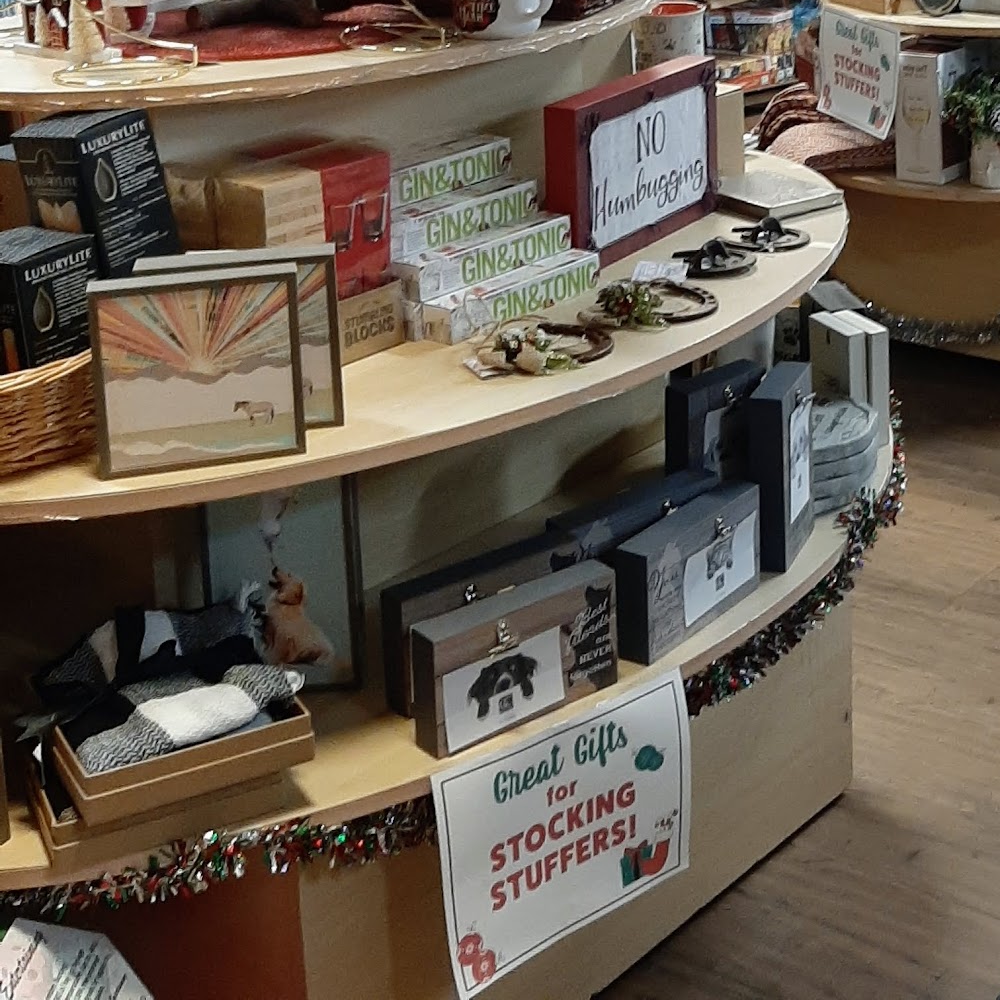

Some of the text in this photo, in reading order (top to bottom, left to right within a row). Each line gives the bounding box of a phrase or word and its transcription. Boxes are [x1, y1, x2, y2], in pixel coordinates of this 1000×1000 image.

[834, 53, 880, 82] STOCKING
[852, 44, 862, 56] for
[834, 71, 879, 102] STUFFERS!
[637, 110, 666, 164] NO
[400, 146, 509, 201] GIN&TONIC
[594, 159, 703, 232] Humbugging
[426, 188, 536, 248] GIN&TONIC
[461, 223, 569, 285] GIN&TONIC
[492, 262, 598, 322] GIN&TONIC
[344, 315, 395, 349] BLOCKS
[580, 643, 612, 665] NEVER
[493, 721, 628, 804] Great Gifts
[547, 780, 578, 807] for
[490, 781, 636, 873] STOCKING
[490, 814, 637, 913] STUFFERS!
